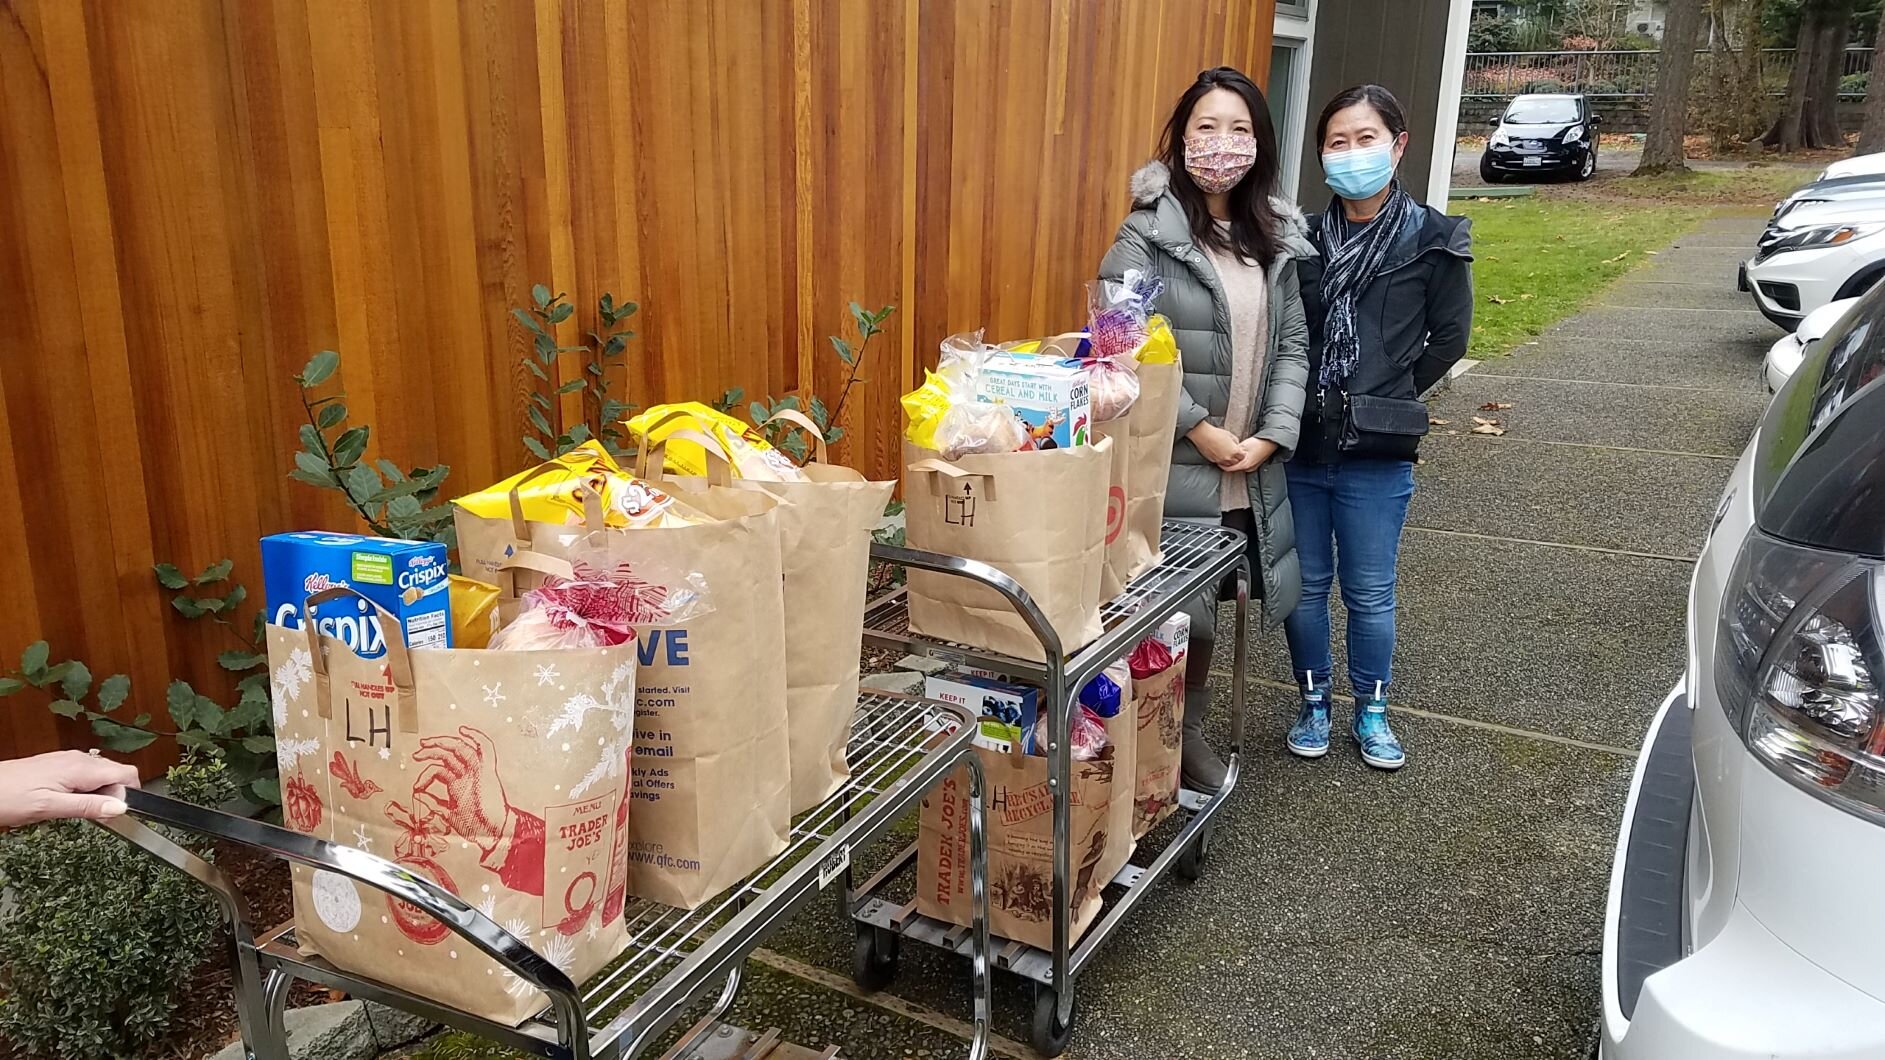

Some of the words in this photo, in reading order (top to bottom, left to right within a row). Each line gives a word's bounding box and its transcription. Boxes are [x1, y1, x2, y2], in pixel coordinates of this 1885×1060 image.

[989, 377, 1006, 386] GREAT
[1007, 379, 1020, 388] DAYS
[1021, 381, 1037, 390] START
[1038, 383, 1052, 391] WITH
[985, 384, 1015, 397] CEREAL
[1018, 389, 1035, 399] AND
[1038, 391, 1058, 402] MILK
[1070, 384, 1089, 400] CORN
[1070, 396, 1089, 411] FLAKES
[945, 495, 975, 527] LH
[304, 571, 350, 593] Kell's
[398, 562, 446, 588] Crispix
[408, 615, 430, 623] Nutrition
[1173, 625, 1188, 640] CORN
[638, 630, 689, 666] VE
[970, 669, 988, 678] KEEP
[638, 686, 671, 694] started.
[672, 686, 690, 694] Visit
[637, 698, 675, 707] c.com
[939, 692, 957, 702] KEEP
[959, 696, 966, 704] IT
[634, 708, 660, 717] gister.
[346, 698, 390, 749] LH
[633, 729, 655, 740] ive
[659, 729, 671, 741] in
[635, 746, 673, 757] email
[632, 768, 646, 778] kly
[650, 768, 669, 777] Ads
[646, 779, 675, 789] Offers
[630, 791, 660, 801] vings
[992, 785, 1007, 812] H
[573, 801, 602, 816] MENU
[942, 778, 956, 830] JOE'S
[559, 814, 609, 839] TRADER
[566, 830, 602, 851] JOE'S
[628, 852, 700, 870] www.qfc.com
[937, 835, 953, 905] TRADER
